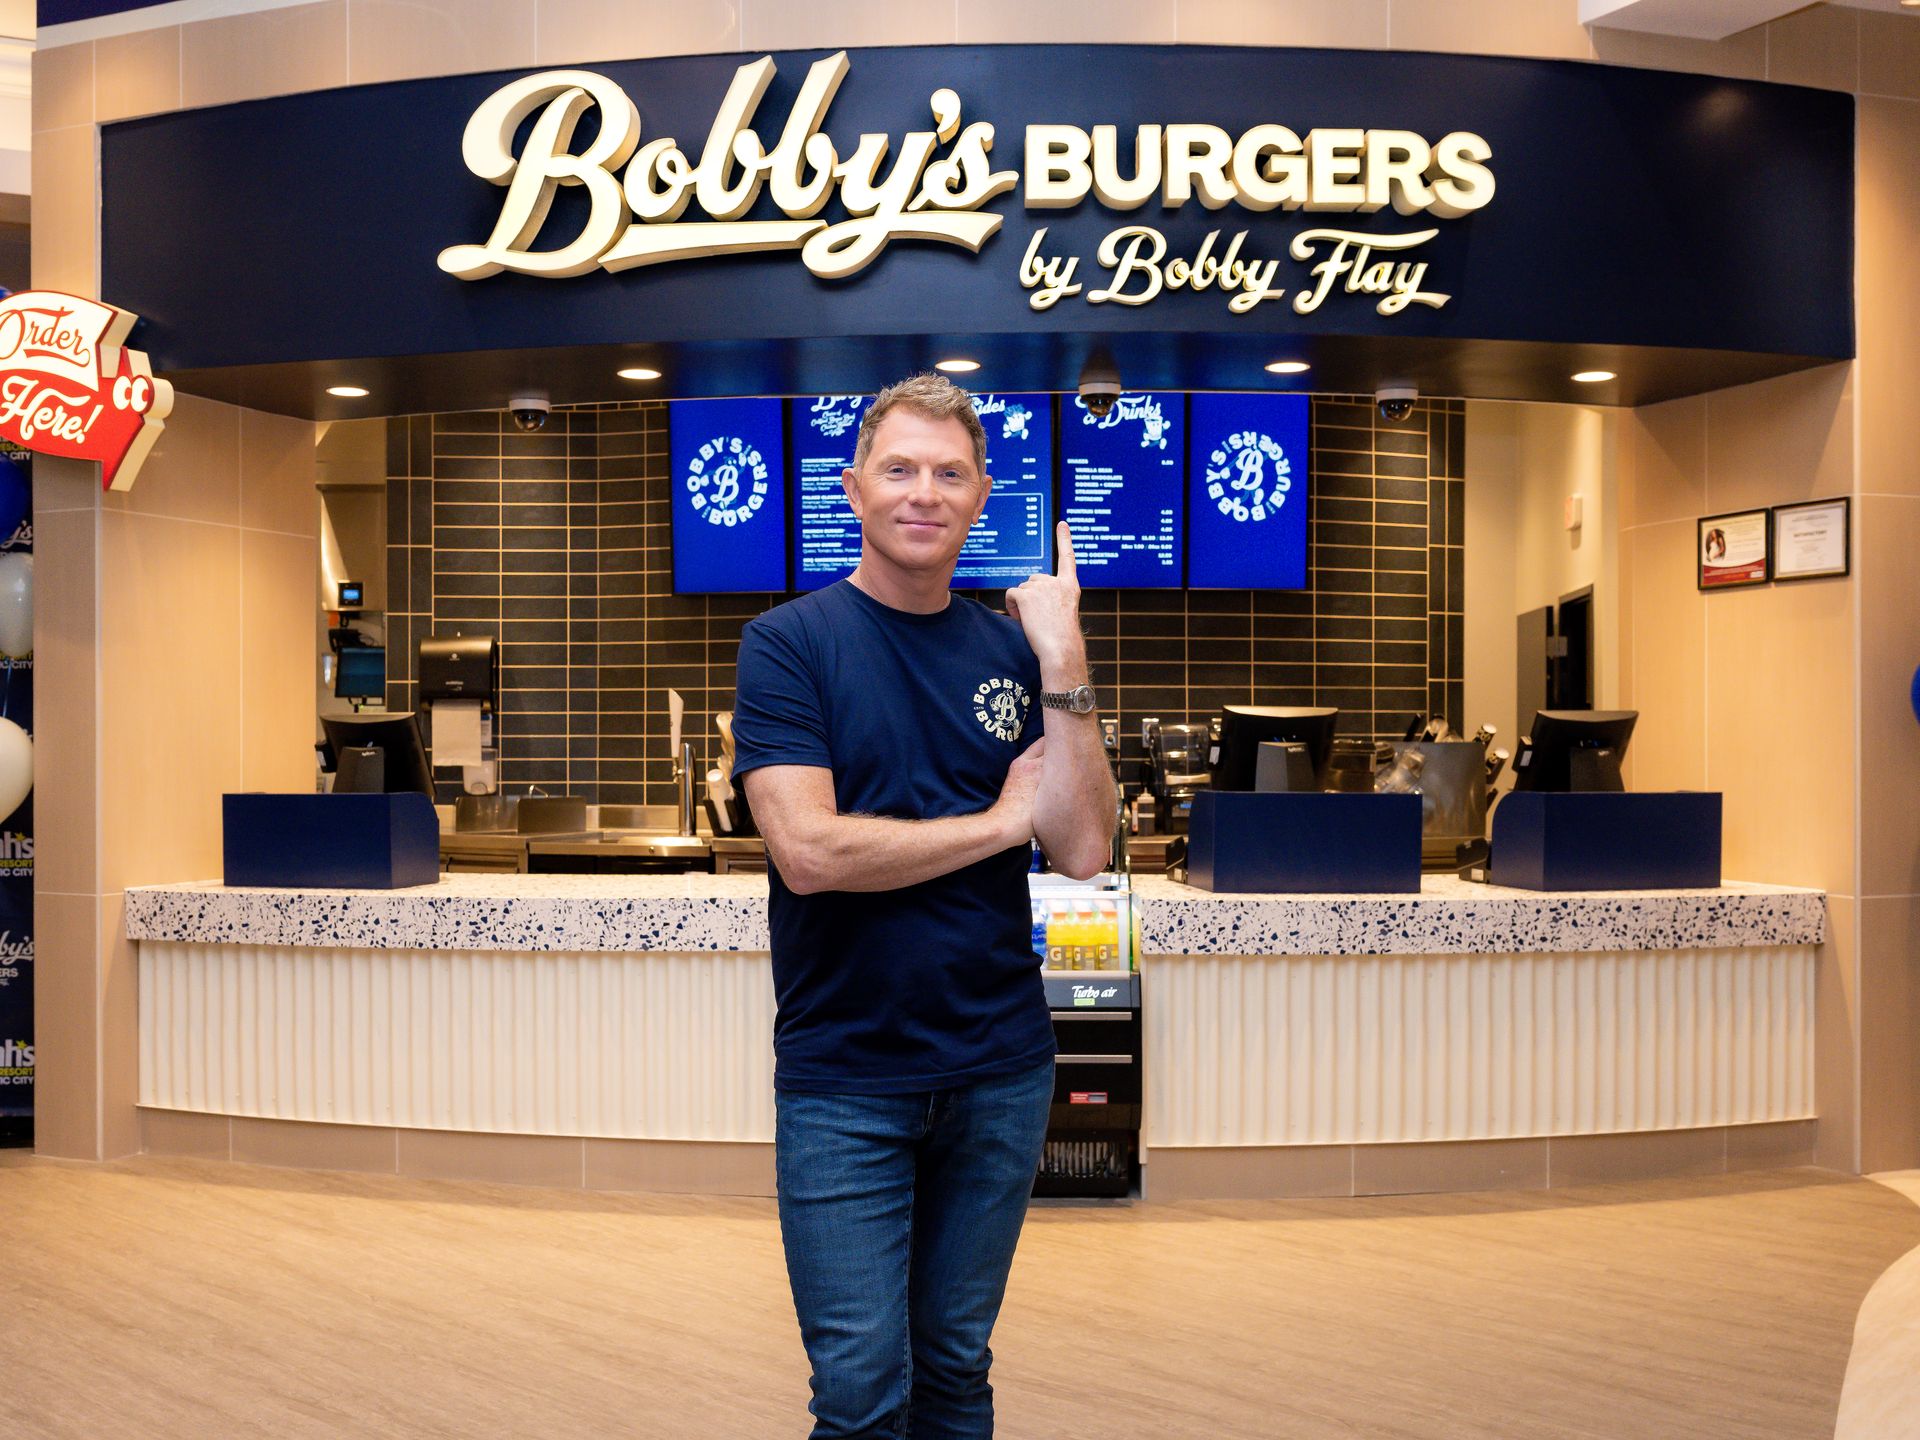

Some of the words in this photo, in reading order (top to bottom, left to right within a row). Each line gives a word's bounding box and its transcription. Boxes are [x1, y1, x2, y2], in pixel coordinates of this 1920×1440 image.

[437, 50, 1018, 280] Bobby's
[1024, 123, 1496, 219] BURGERS
[1019, 226, 1082, 311] by
[1086, 225, 1285, 314] Bobby
[1289, 228, 1452, 316] Flay
[0, 306, 91, 368] Order
[0, 375, 104, 445] Here!
[1097, 395, 1162, 430] Drinks
[687, 436, 743, 511] BOBBY'S
[708, 450, 768, 527] BURGERS
[1205, 449, 1267, 522] BOBBY'S
[973, 678, 1030, 707] BOBBY'S
[12, 868, 33, 876] CITY
[1072, 985, 1100, 998] Turbo
[1101, 986, 1118, 998] air
[12, 1076, 34, 1085] CITY
